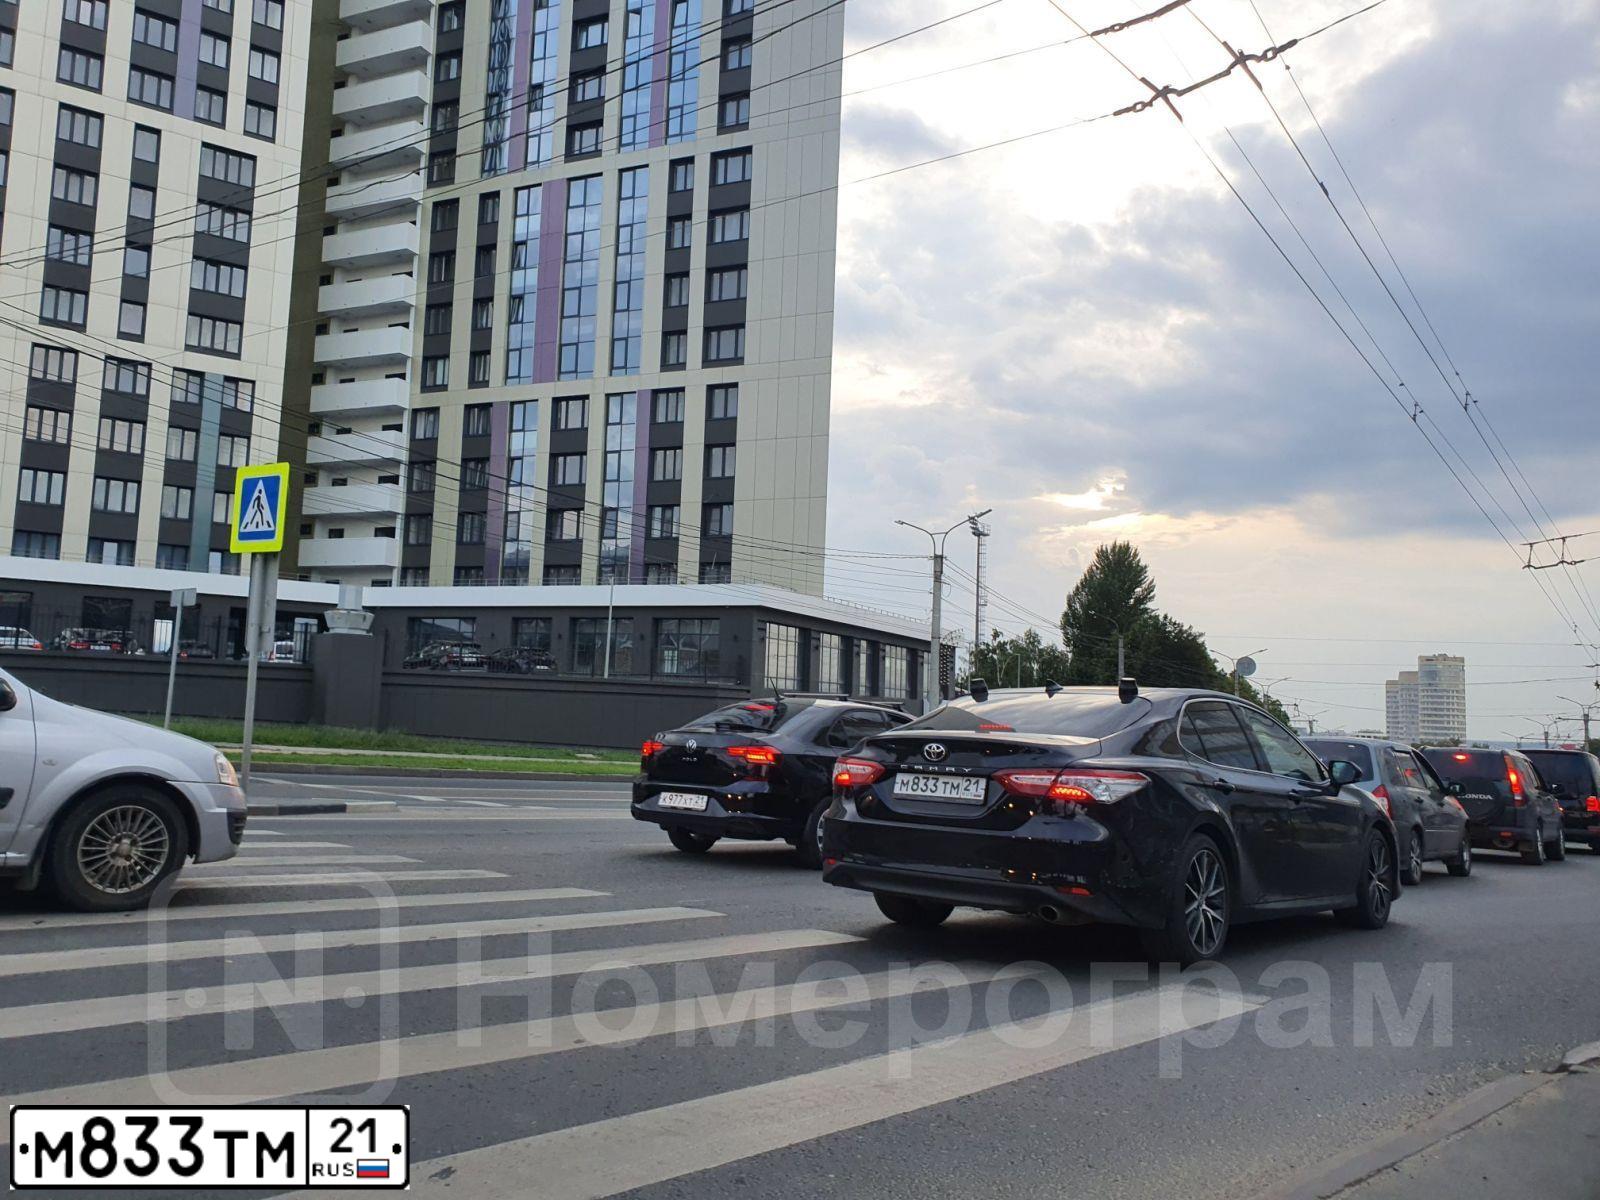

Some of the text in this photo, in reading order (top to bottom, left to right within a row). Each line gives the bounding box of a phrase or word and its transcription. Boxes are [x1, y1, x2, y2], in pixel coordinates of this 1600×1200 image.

[900, 764, 971, 772] CAMRY
[899, 776, 980, 796] М833ТМ 21
